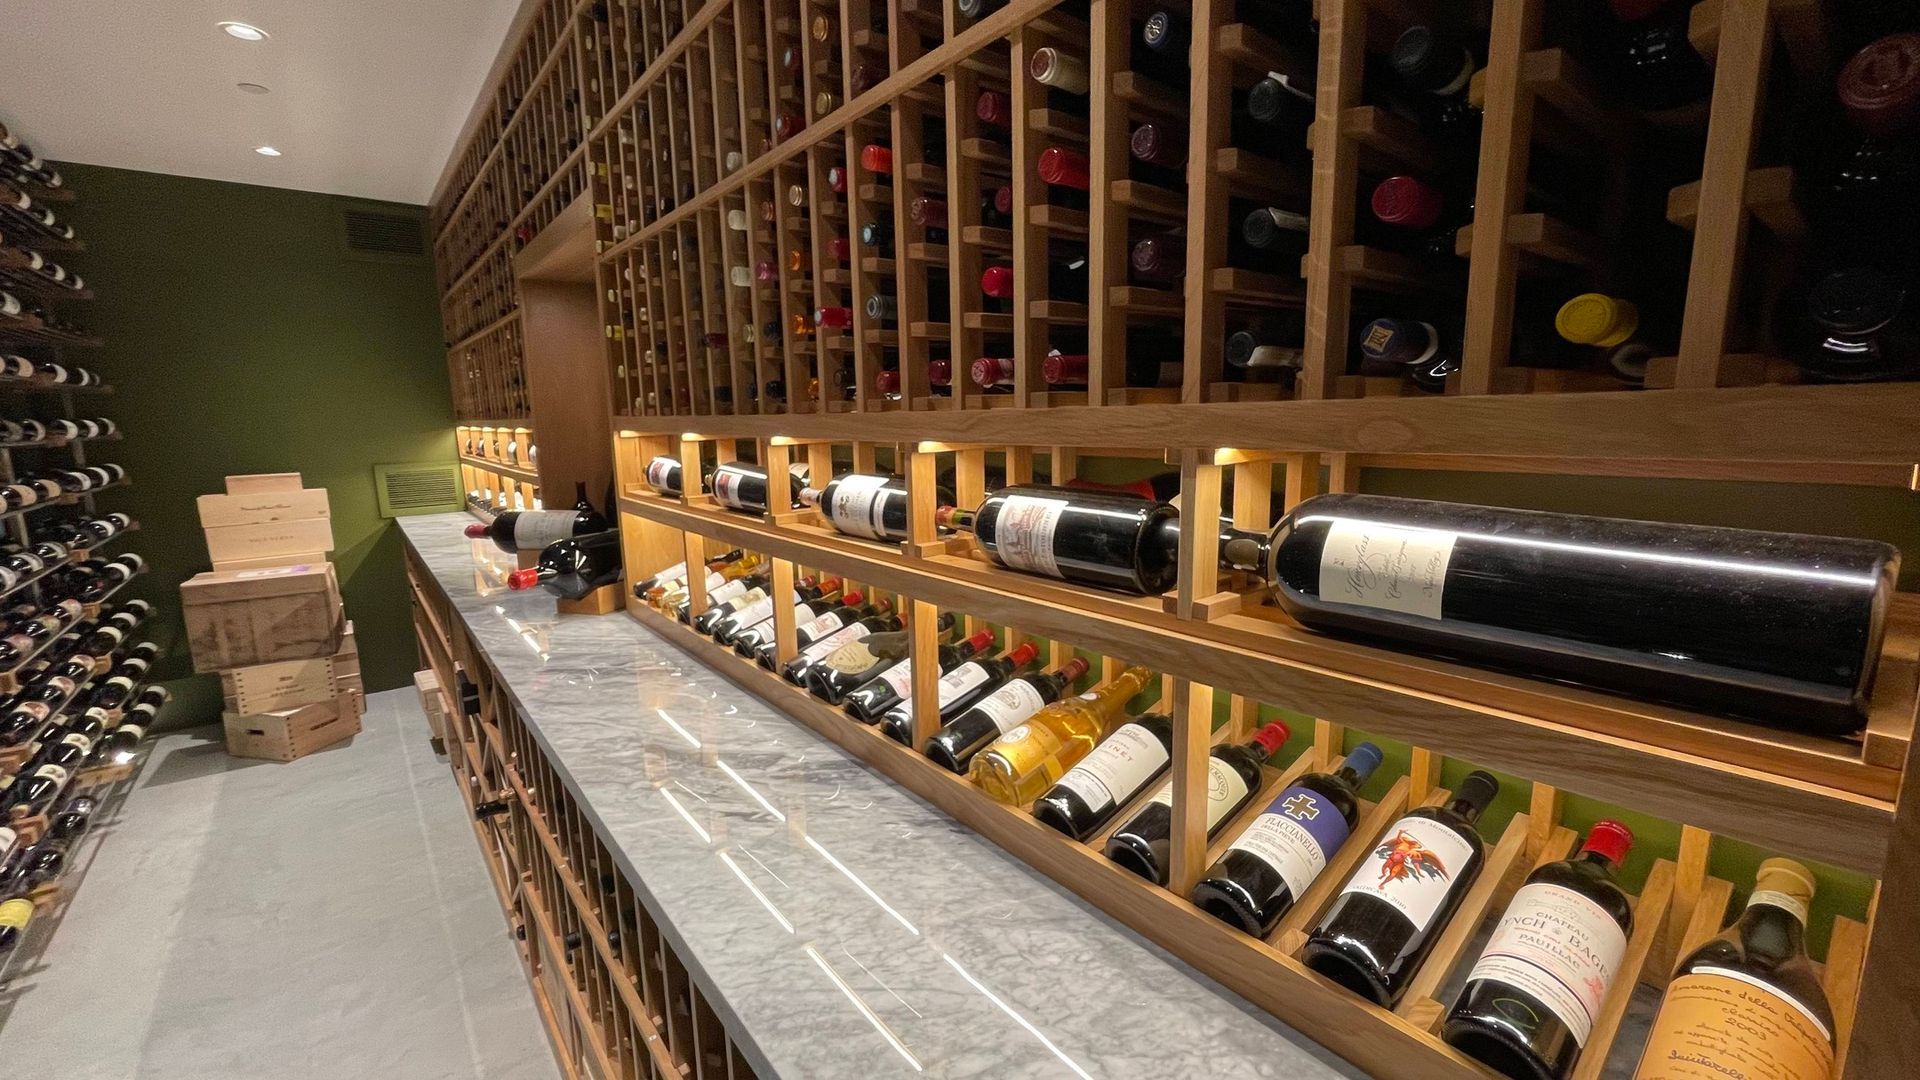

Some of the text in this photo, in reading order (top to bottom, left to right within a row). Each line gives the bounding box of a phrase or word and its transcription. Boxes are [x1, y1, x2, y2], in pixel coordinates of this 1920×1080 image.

[1265, 816, 1319, 861] FLACCIANELLO
[1504, 917, 1546, 930] YNCH
[1519, 933, 1582, 970] PAUILLAC
[1738, 991, 1779, 1016] della
[1724, 1016, 1768, 1042] 2003
[1668, 1049, 1752, 1080] Quintarell
